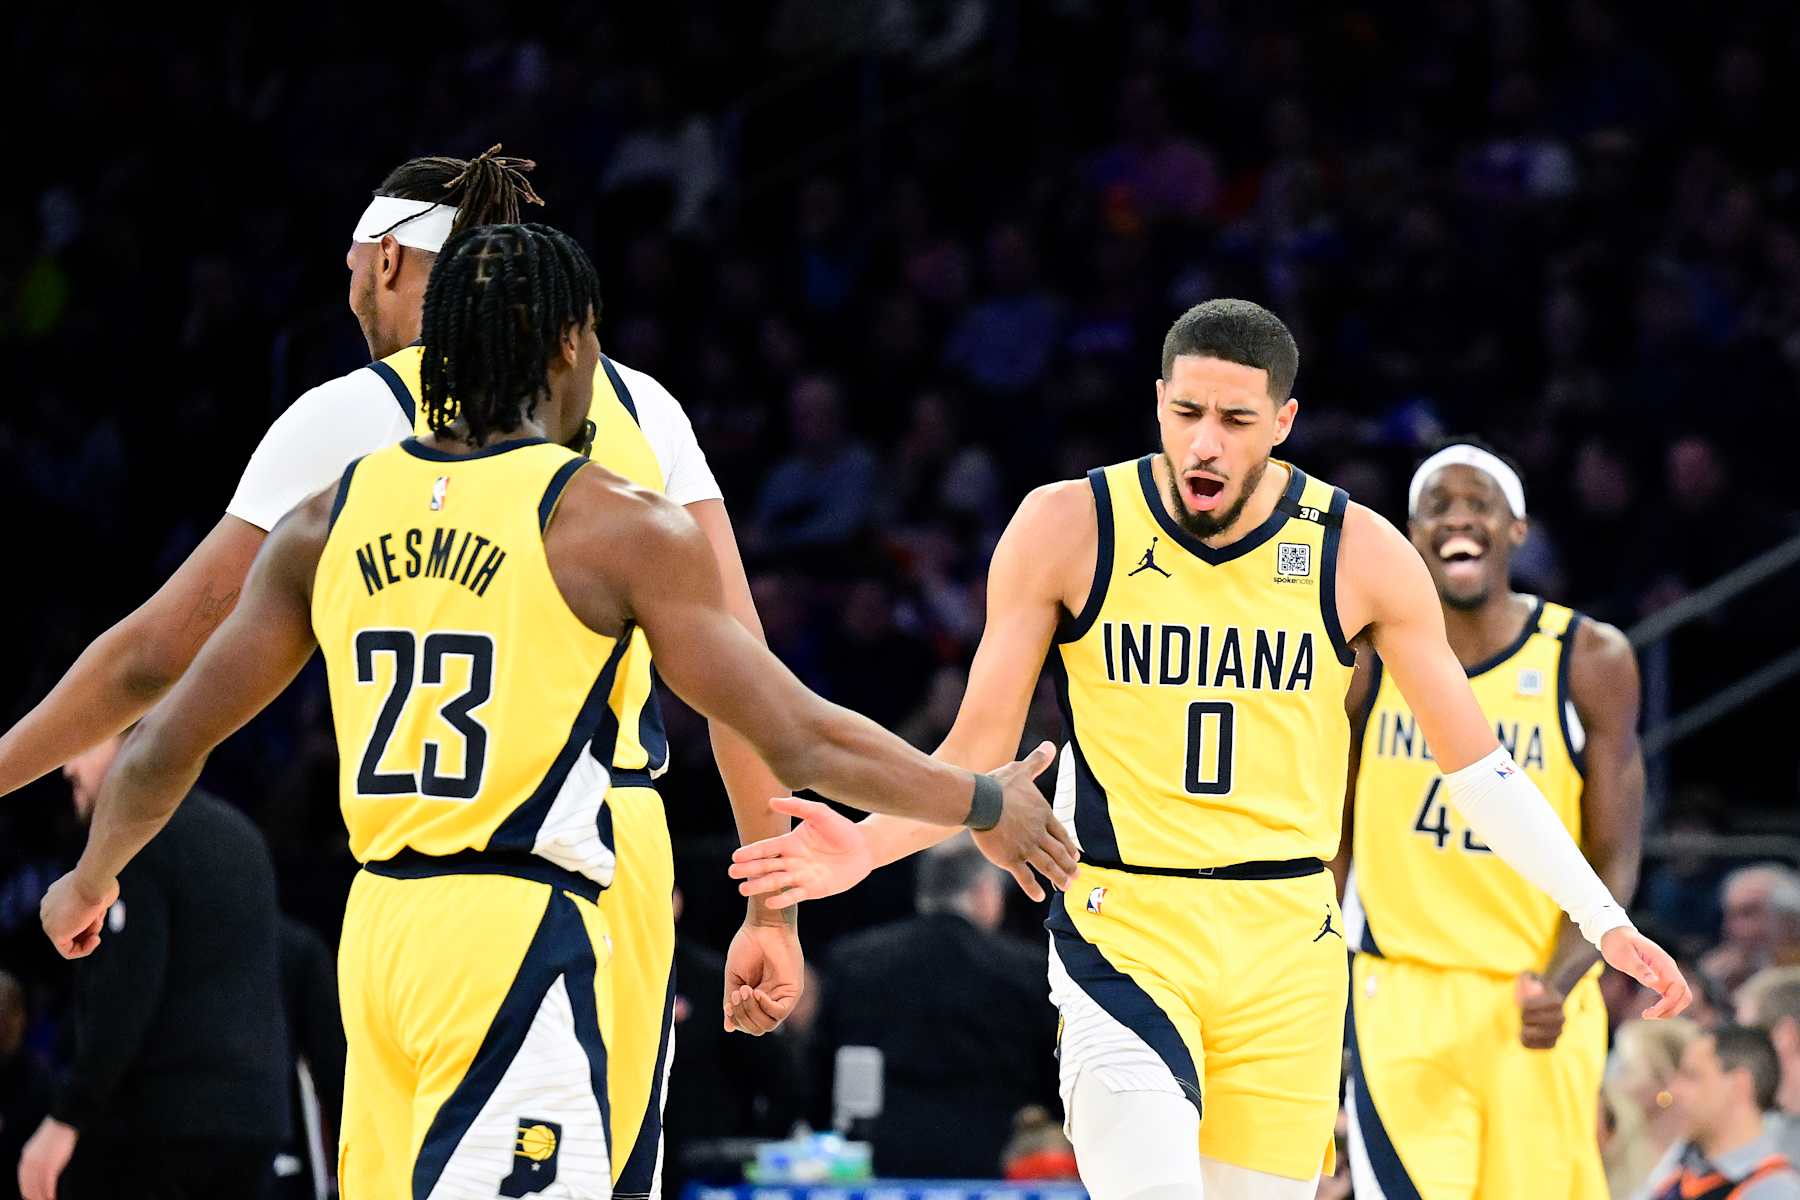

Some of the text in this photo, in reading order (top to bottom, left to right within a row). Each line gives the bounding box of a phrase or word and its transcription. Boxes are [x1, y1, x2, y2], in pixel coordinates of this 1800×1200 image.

[1299, 507, 1320, 522] 30
[355, 527, 507, 597] NESMITH
[1273, 576, 1314, 586] spokenote
[1103, 622, 1314, 691] INDIANA
[355, 629, 494, 799] 23
[1184, 701, 1235, 795] 0
[1377, 711, 1544, 770] INNA
